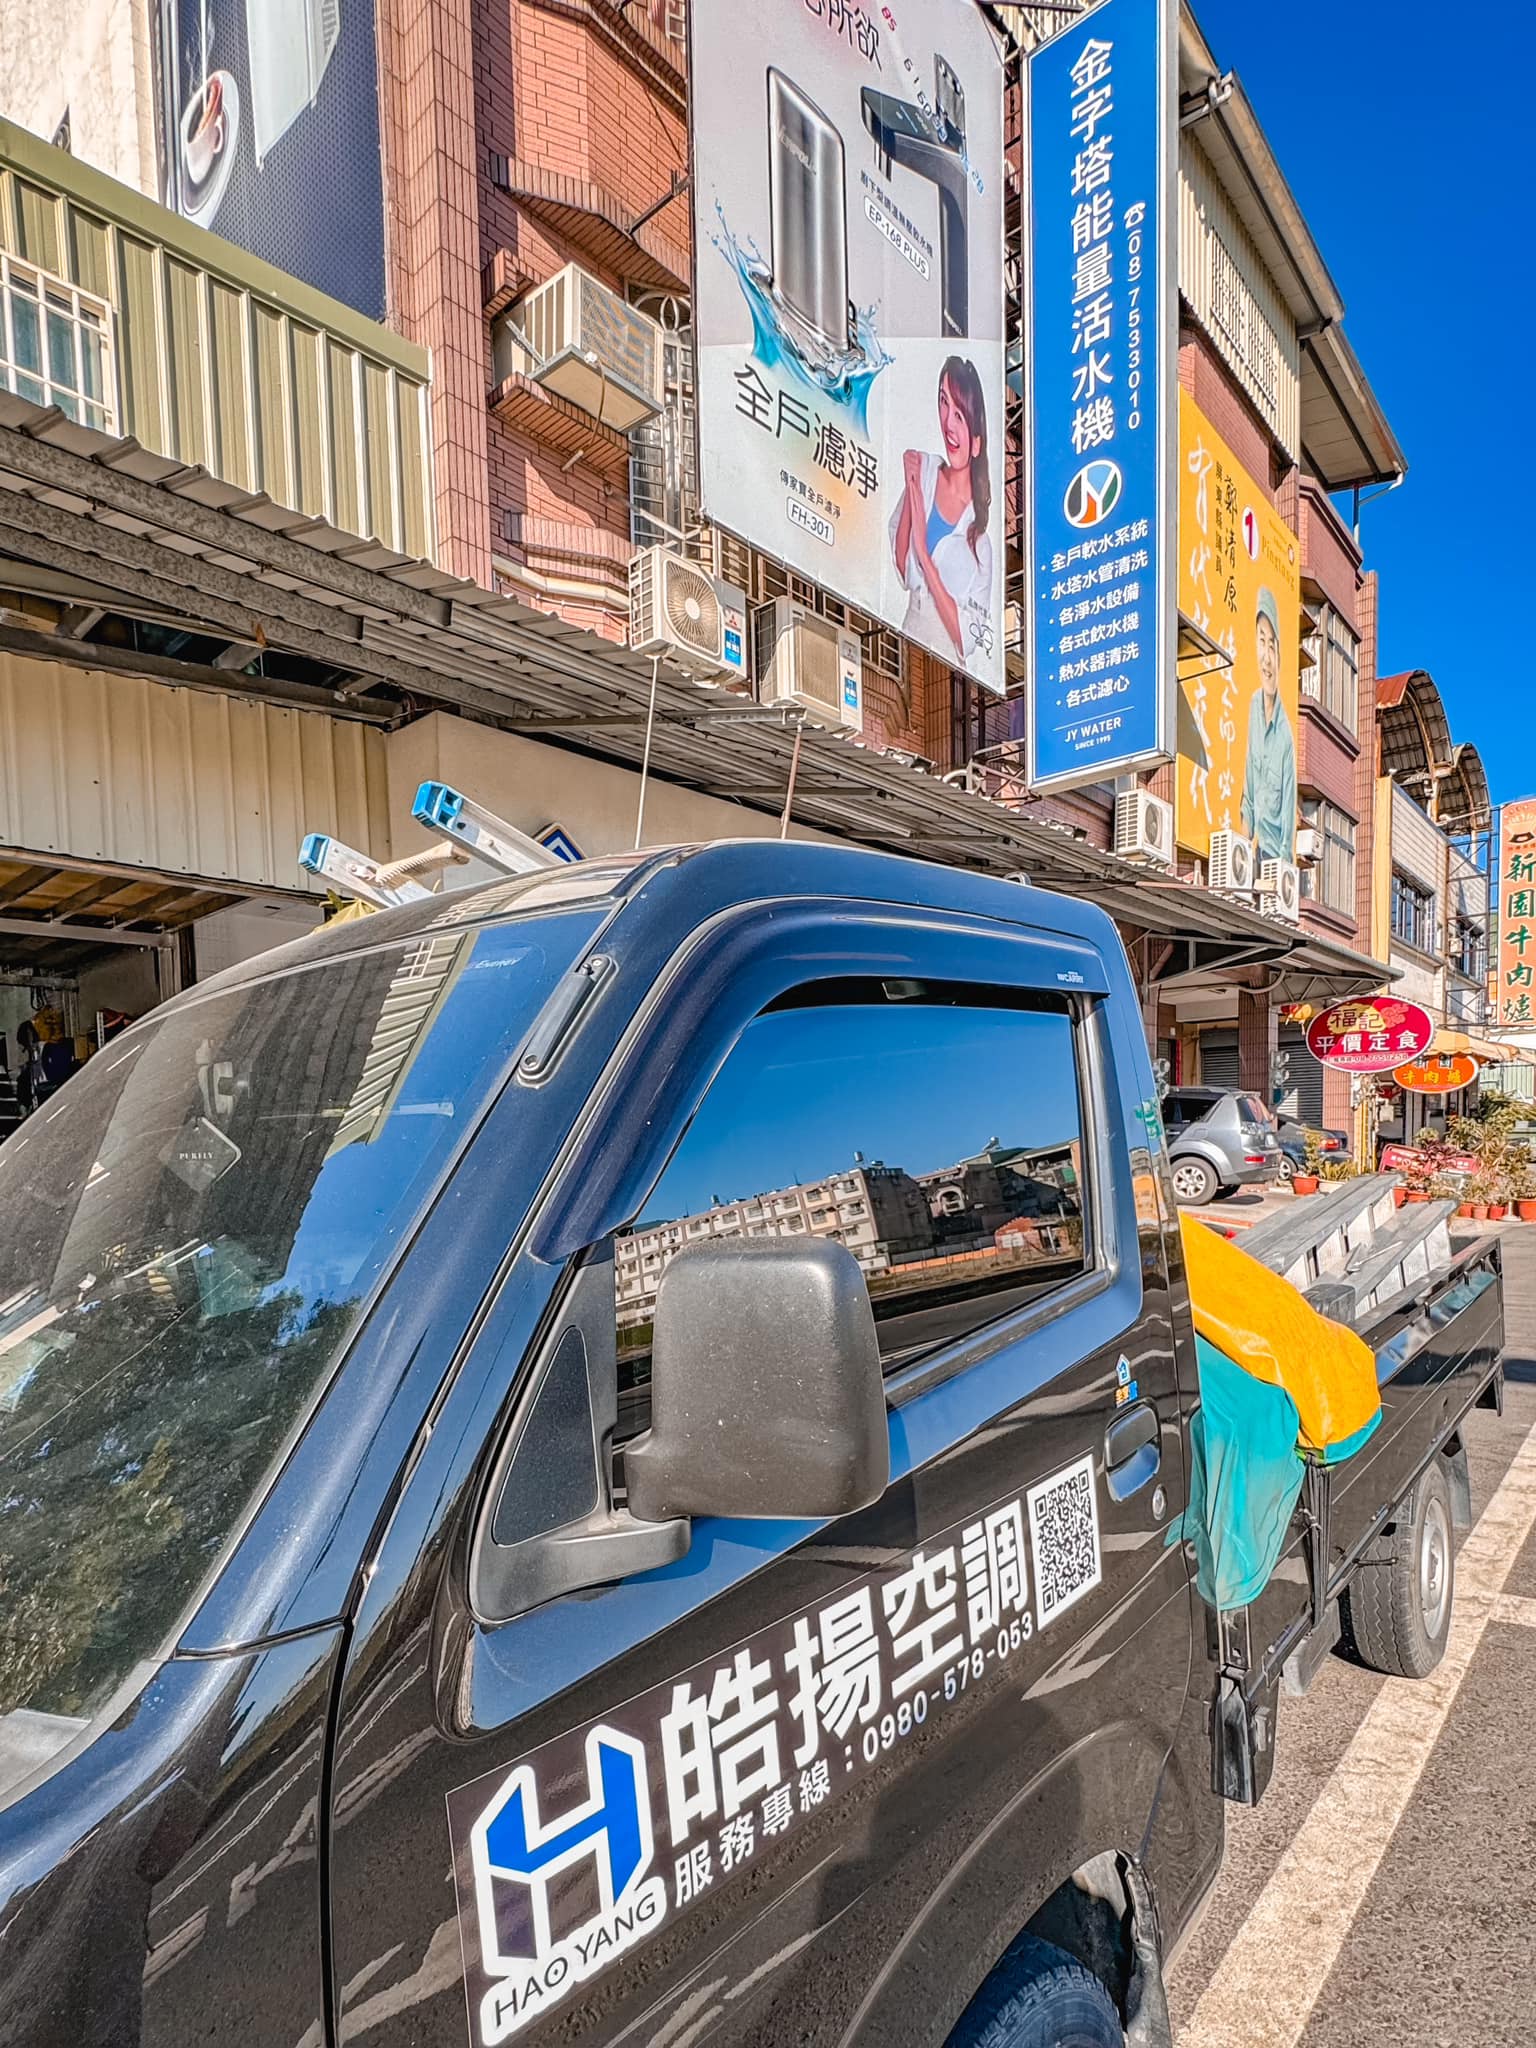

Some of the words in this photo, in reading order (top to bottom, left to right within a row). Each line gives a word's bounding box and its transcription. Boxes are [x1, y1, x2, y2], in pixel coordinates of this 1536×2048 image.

[869, 204, 902, 248] EP-168
[903, 242, 927, 274] PLUS
[1069, 37, 1115, 454] 金字塔能量活水機
[733, 363, 879, 499] 全戶濾淨
[791, 503, 829, 539] FH-301
[1050, 518, 1149, 573] 全戶軟水系統
[1050, 549, 1149, 602] 水塔水管清洗
[1058, 582, 1140, 627] 各淨水設備
[1058, 611, 1140, 655] 各式飲水機
[1058, 641, 1140, 684] 熱水器清洗
[1065, 674, 1130, 708] 各式濾心
[1064, 728, 1078, 743] JY
[1081, 716, 1121, 738] WATER
[1075, 739, 1095, 751] SINCE
[1331, 1008, 1383, 1030] 福記
[1315, 1029, 1419, 1054] 平價定食
[660, 1499, 1028, 1847] 皓揚空調
[494, 1956, 569, 2028] HAO
[575, 1892, 658, 1966] YANG
